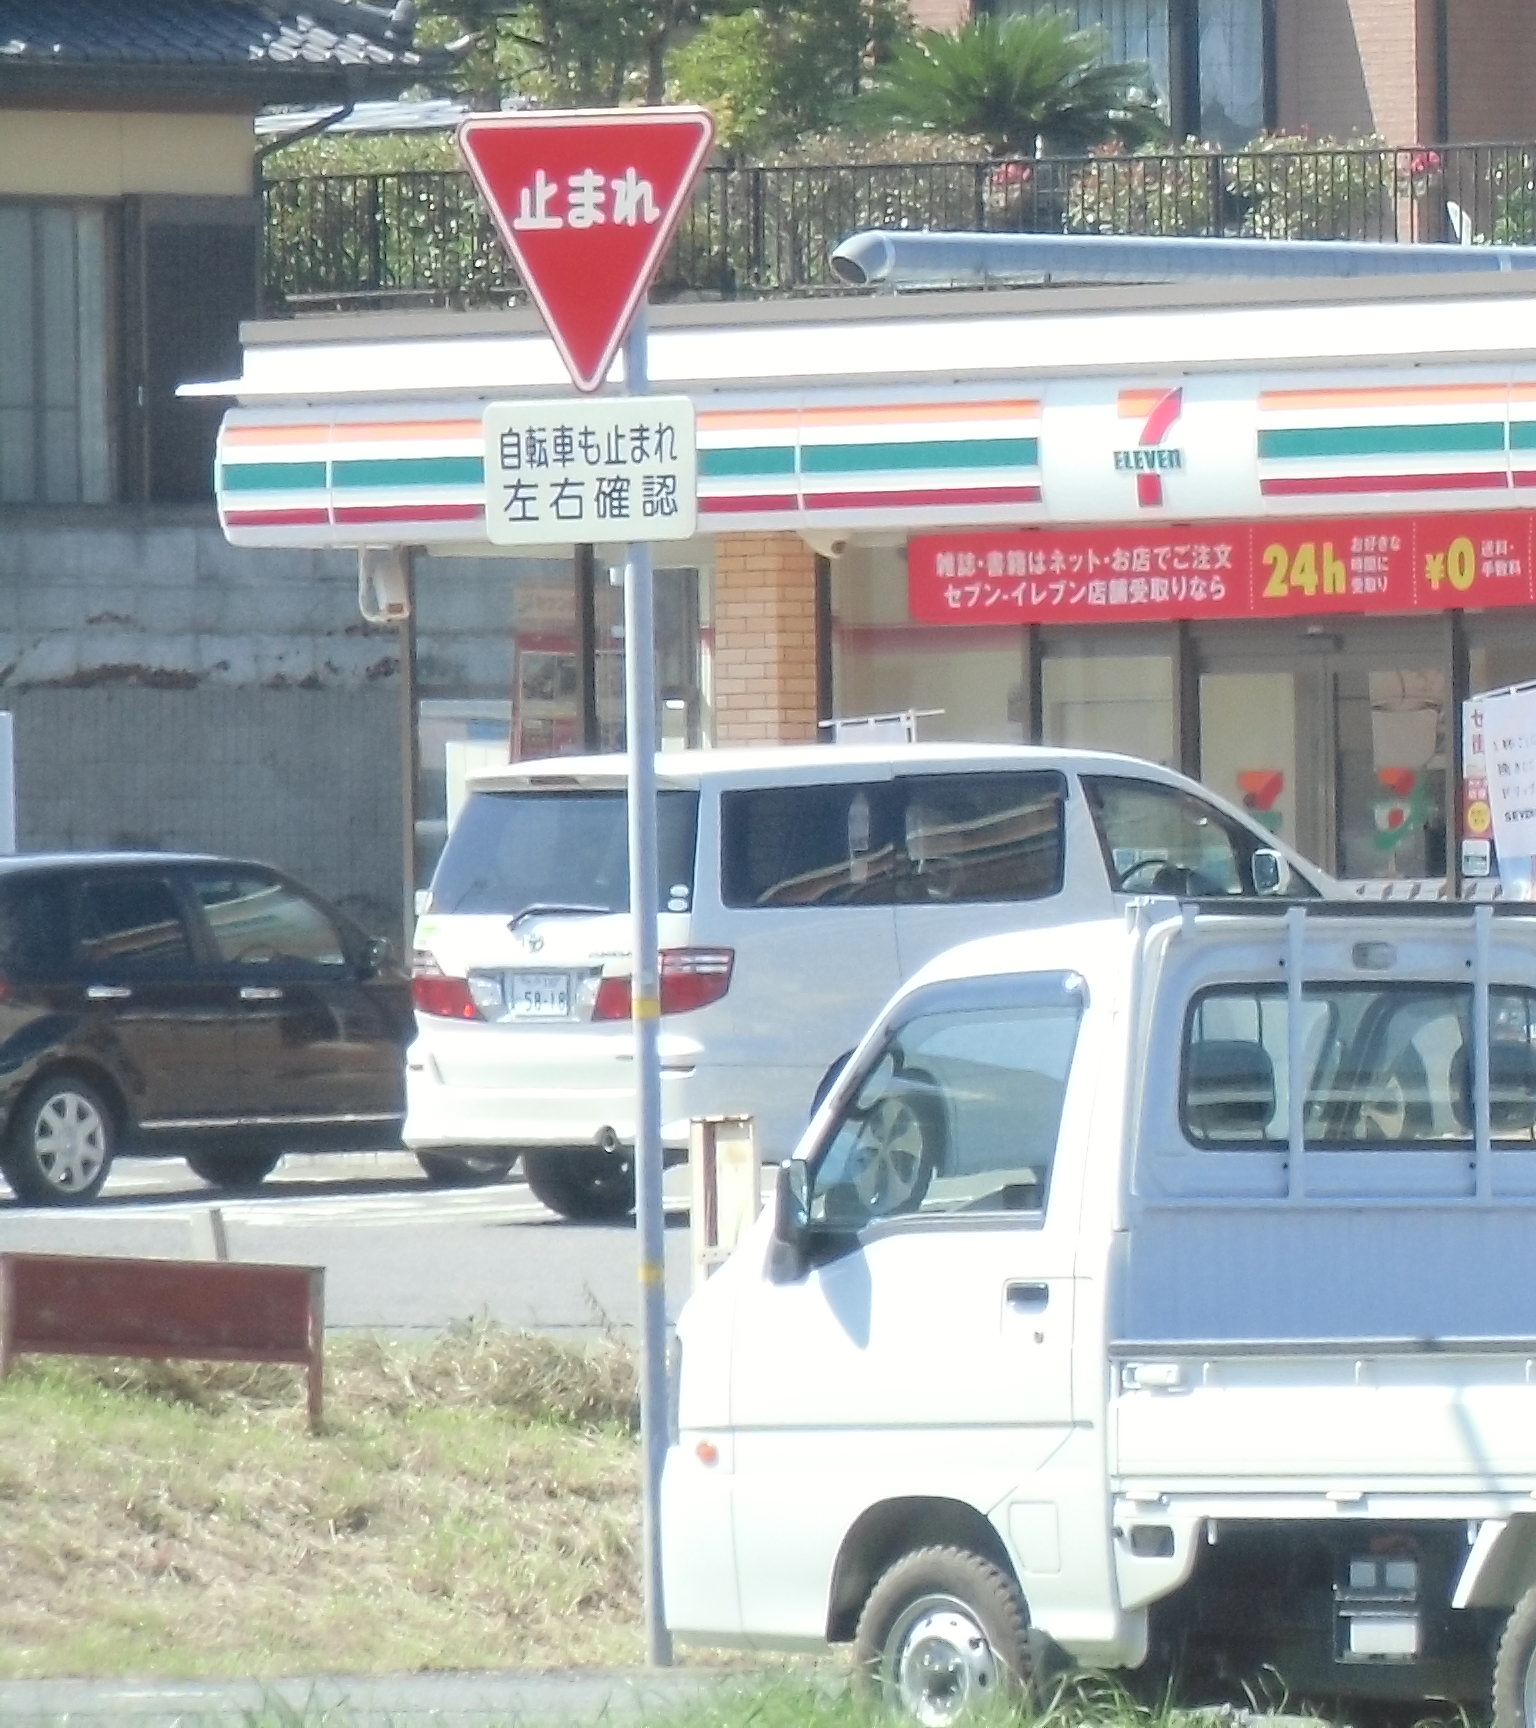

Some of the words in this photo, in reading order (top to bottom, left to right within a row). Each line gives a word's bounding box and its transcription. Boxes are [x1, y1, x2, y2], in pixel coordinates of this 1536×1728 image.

[513, 165, 661, 232] 止まれ
[499, 421, 678, 471] 自転車も止まれ
[502, 474, 679, 523] 左右確認
[1261, 540, 1347, 599] 24h
